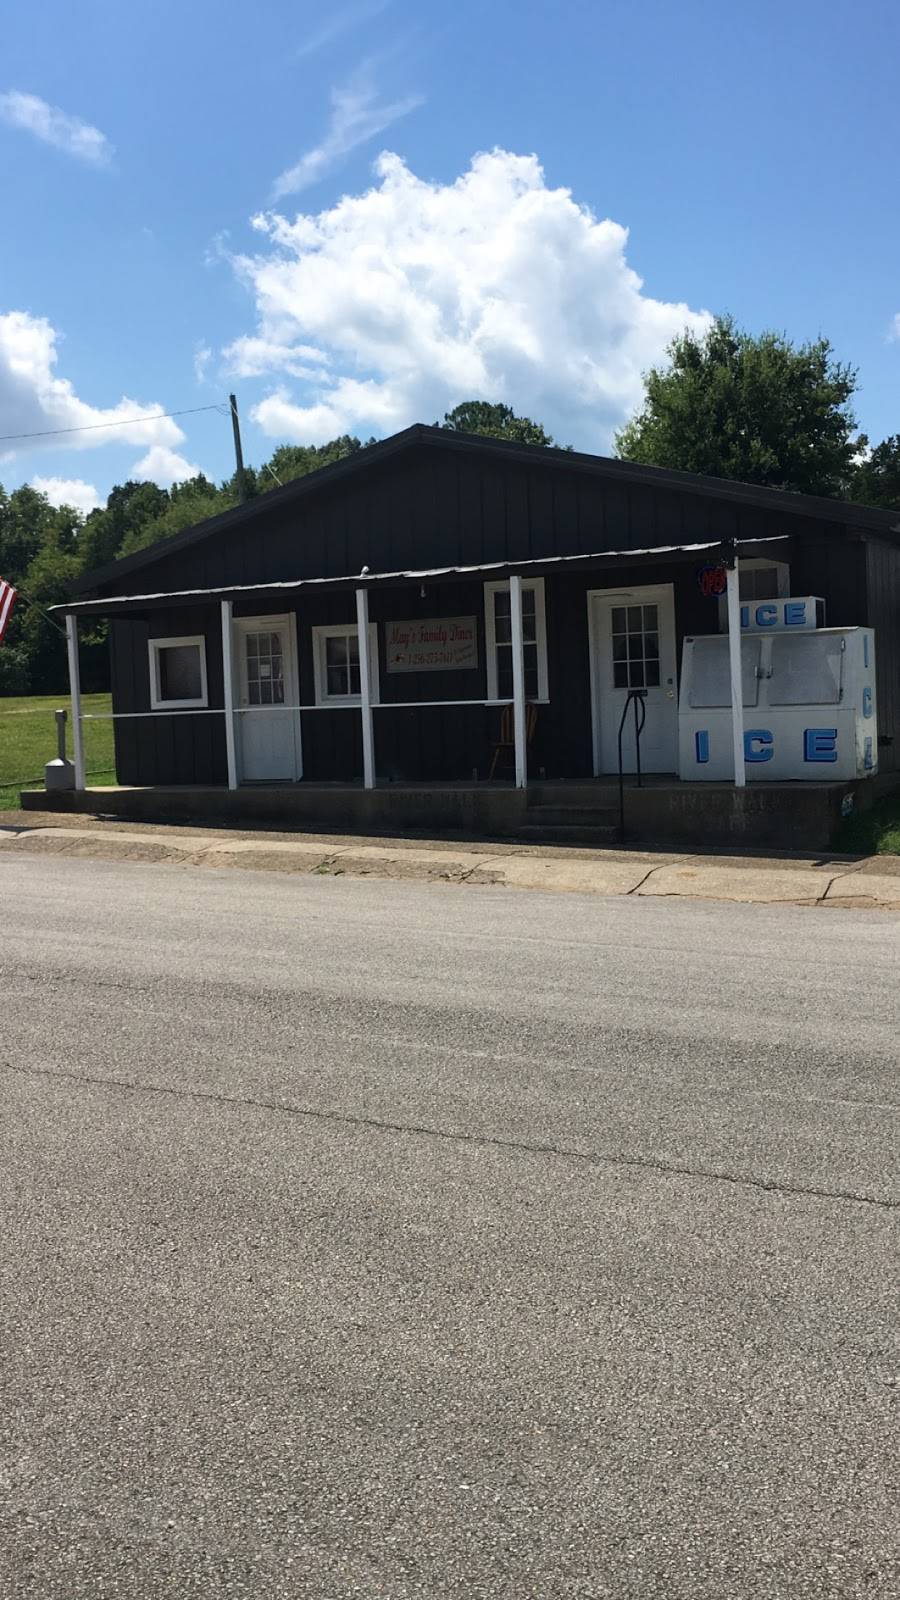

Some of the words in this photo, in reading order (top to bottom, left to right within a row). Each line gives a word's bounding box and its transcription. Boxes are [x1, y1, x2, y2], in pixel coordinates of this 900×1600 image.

[740, 602, 806, 627] ICE
[418, 624, 448, 647] Family
[450, 623, 474, 641] Diner
[695, 728, 838, 763] ICE
